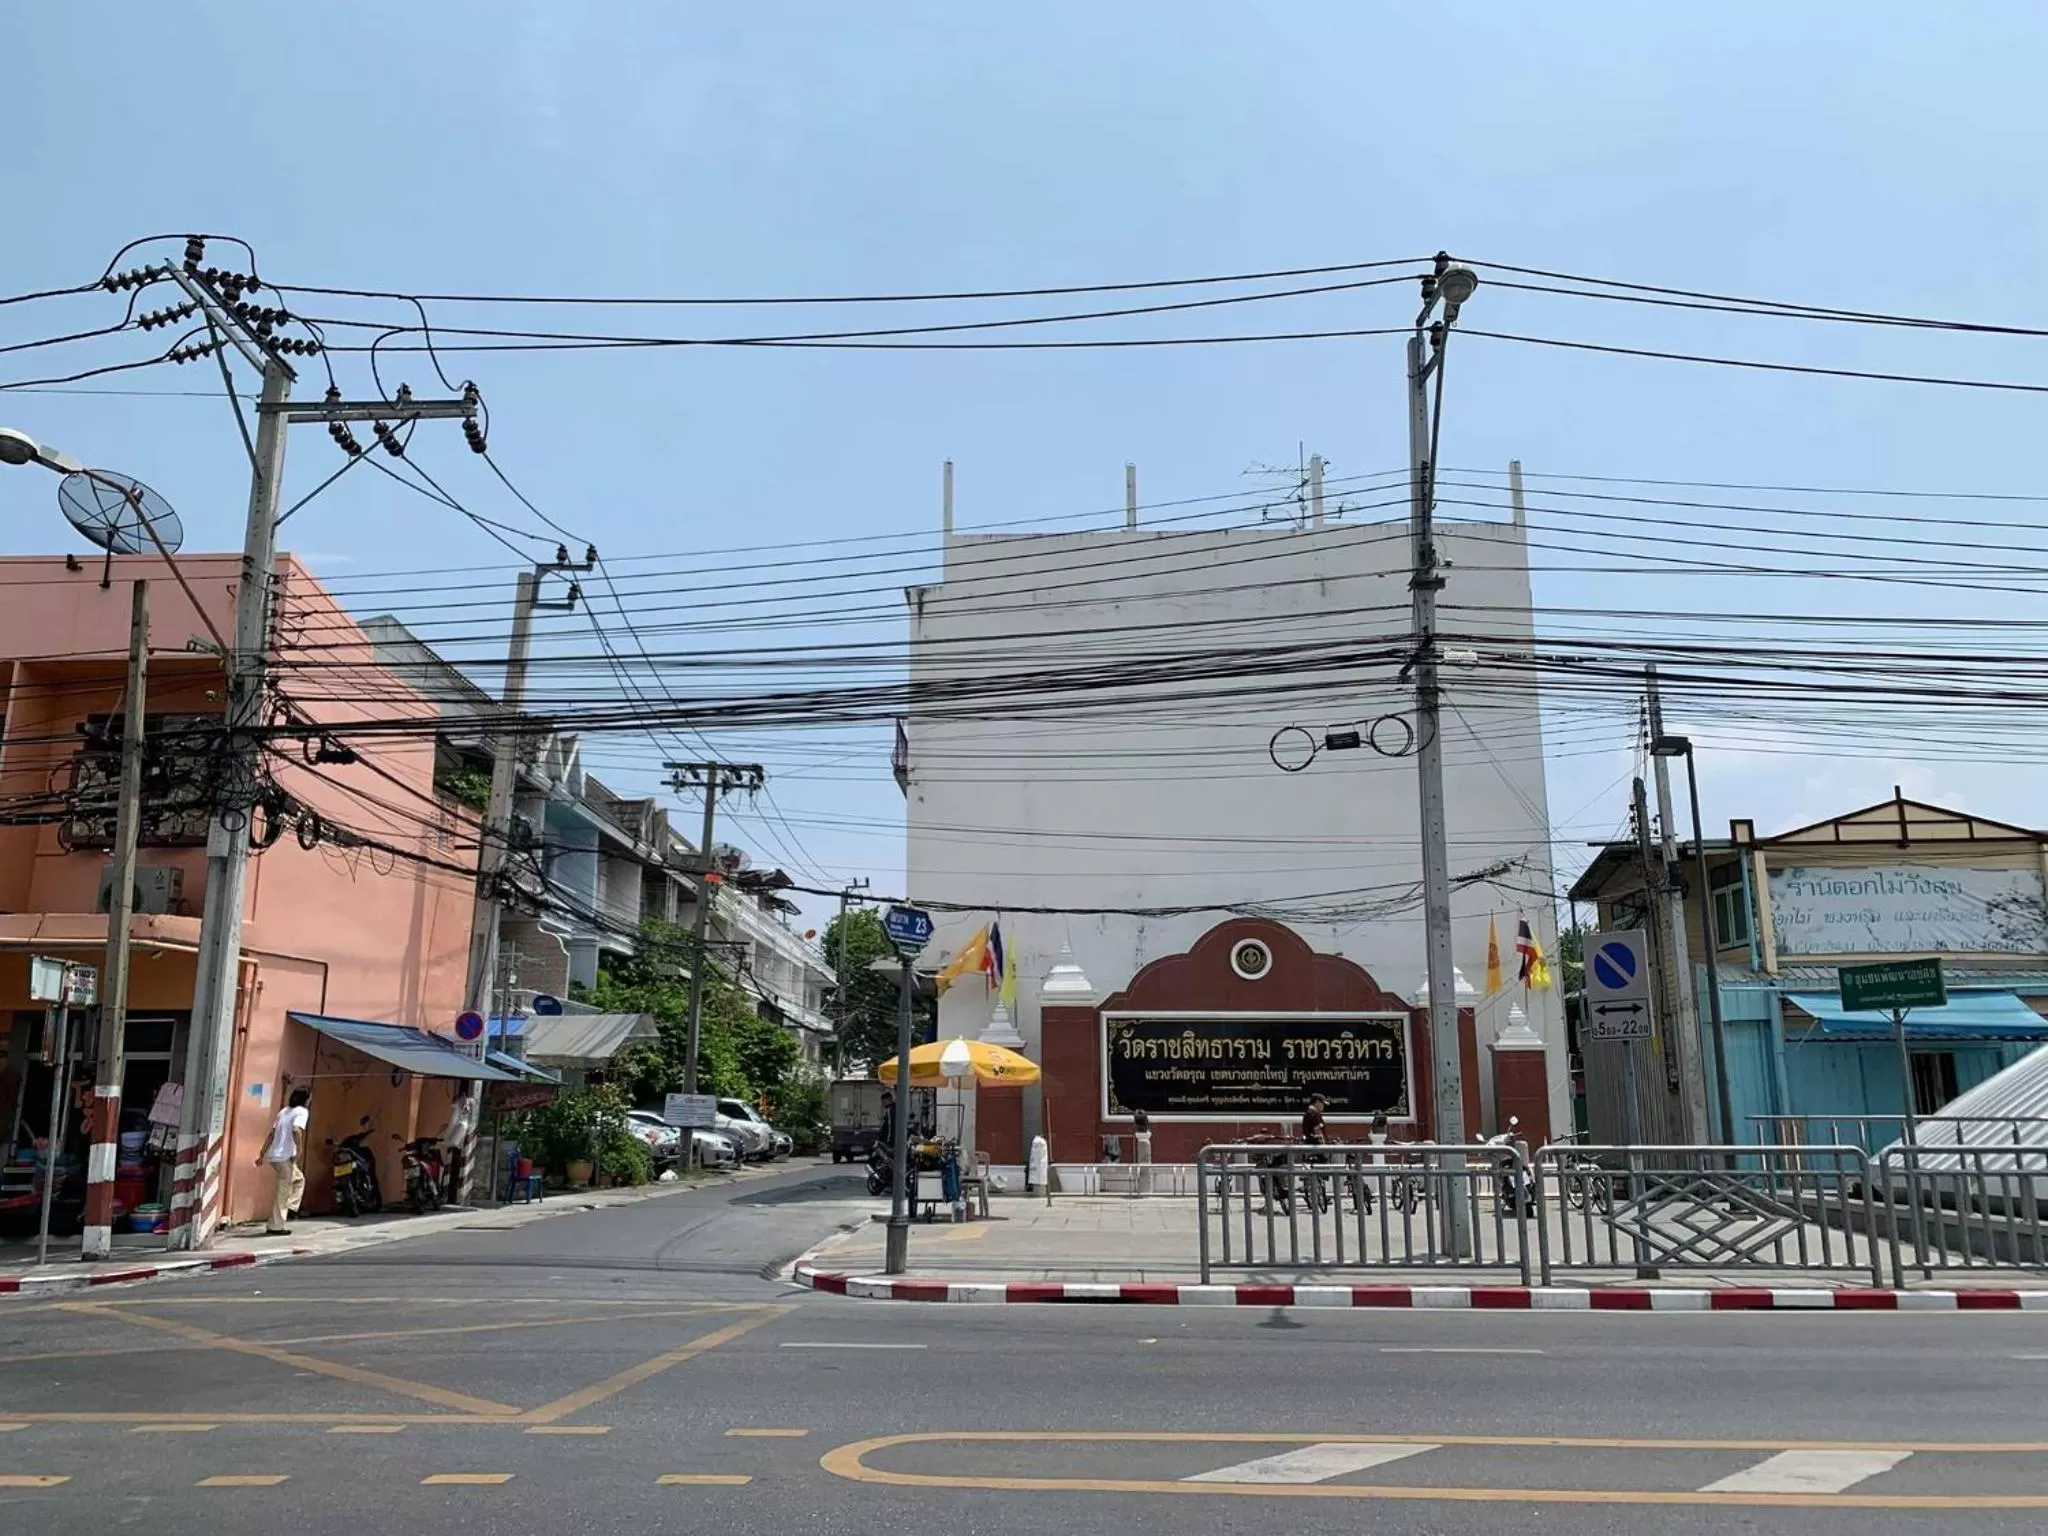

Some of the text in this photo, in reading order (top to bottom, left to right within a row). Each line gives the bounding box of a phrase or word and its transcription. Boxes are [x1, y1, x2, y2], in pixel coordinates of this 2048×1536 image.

[915, 917, 927, 935] 23
[1119, 1029, 1394, 1060] วัดราชสิทธาราม ราชวรวิหาร
[1144, 1066, 1206, 1084] แขวงวัดอรุณ
[1293, 1068, 1370, 1085] กรุงเทพมหานคร
